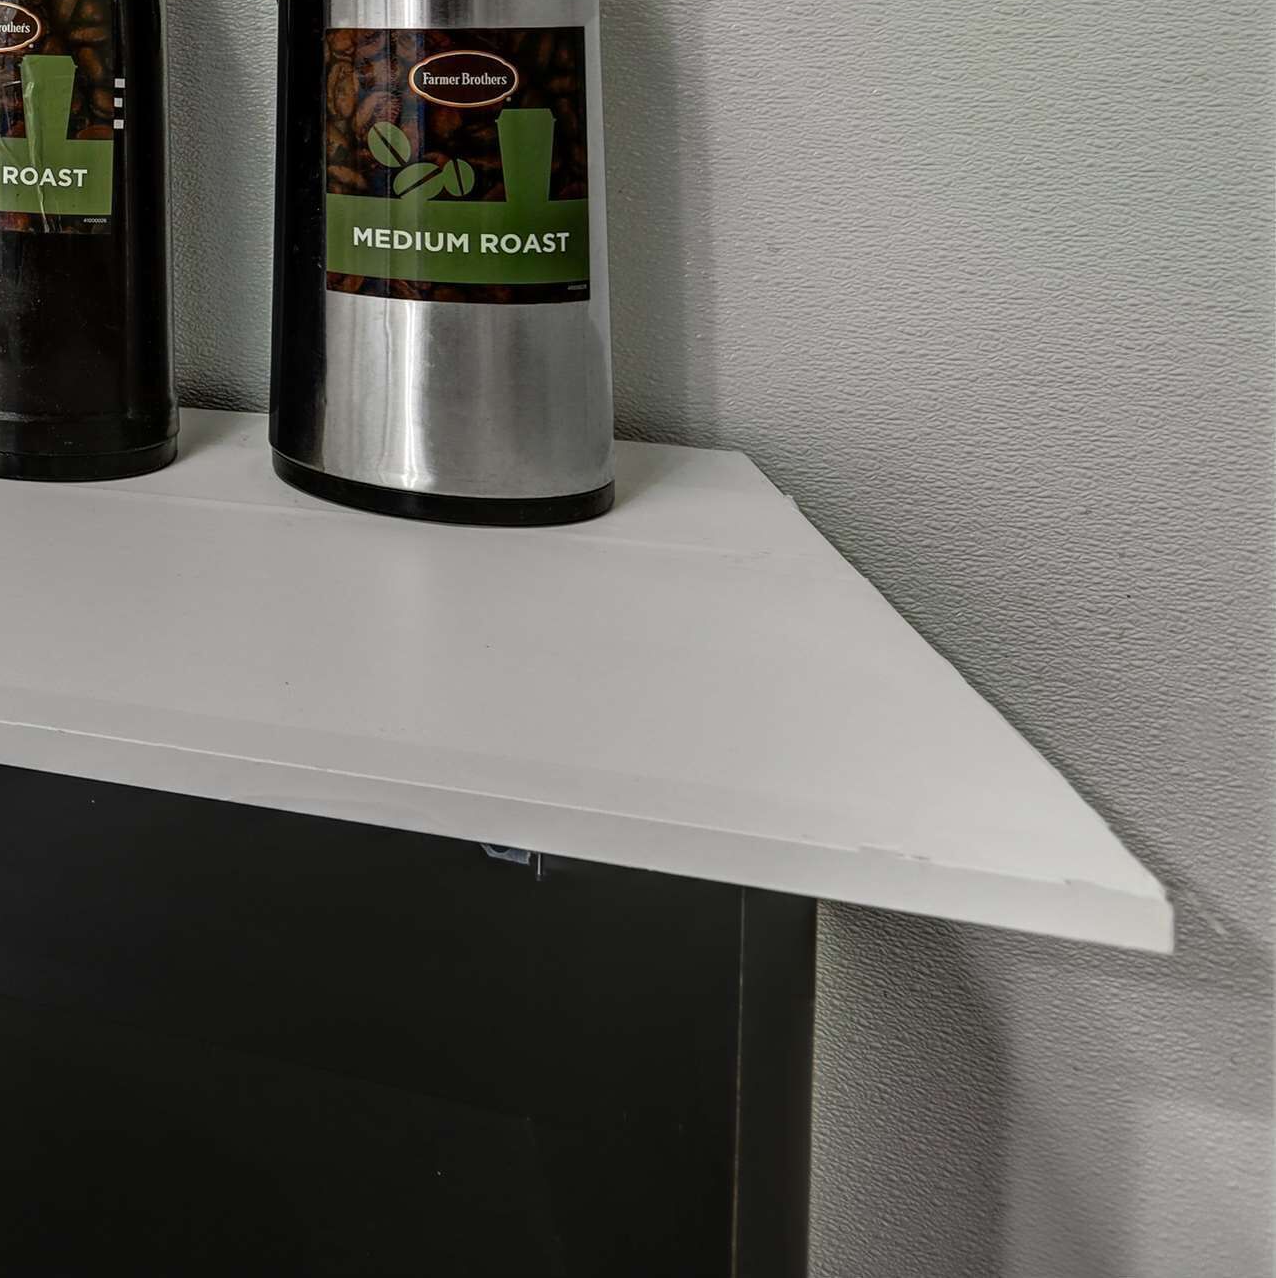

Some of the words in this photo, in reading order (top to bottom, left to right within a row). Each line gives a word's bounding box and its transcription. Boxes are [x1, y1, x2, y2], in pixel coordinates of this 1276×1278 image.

[422, 72, 461, 86] Farmer
[461, 73, 508, 86] Brothers
[2, 166, 87, 187] ROAST
[353, 226, 470, 254] MEDIUM
[480, 232, 570, 254] ROAST
